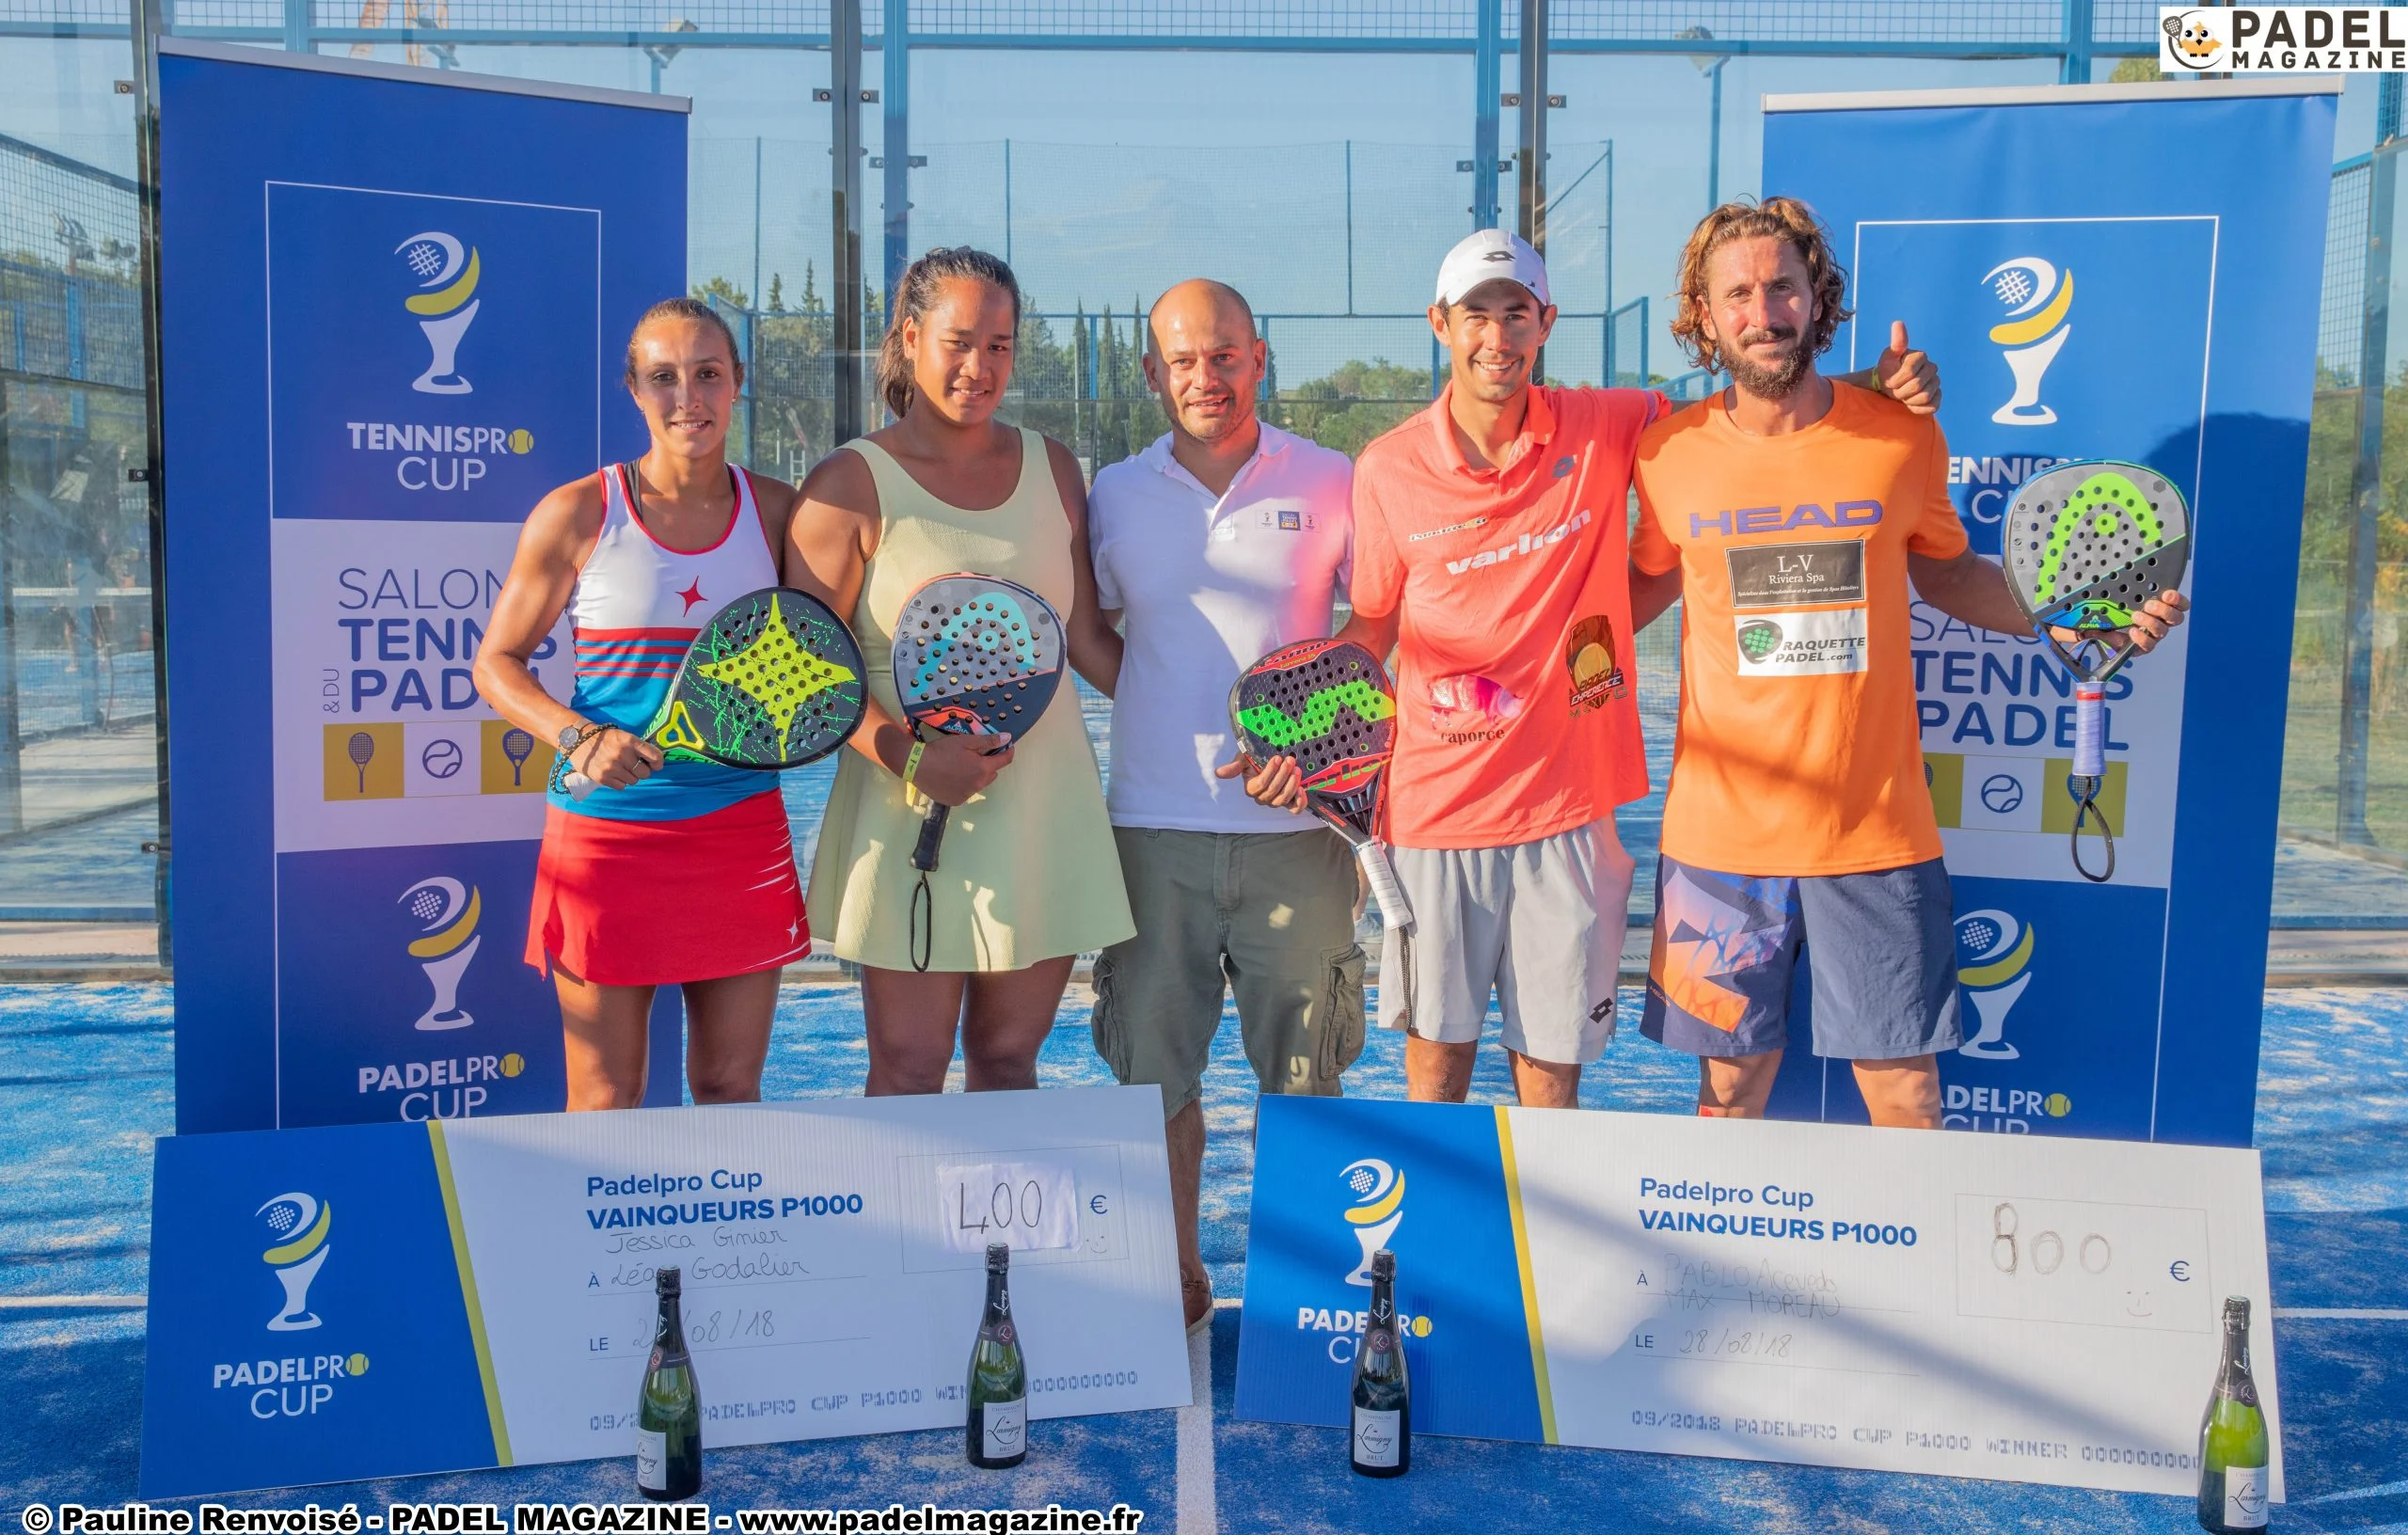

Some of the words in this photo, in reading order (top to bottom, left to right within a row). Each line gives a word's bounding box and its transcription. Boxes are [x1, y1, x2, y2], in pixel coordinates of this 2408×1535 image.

[398, 456, 486, 491] CUP
[1689, 499, 1883, 538] HEAD
[1446, 509, 1592, 576] varlion
[1768, 574, 1803, 584] Riviera
[1806, 572, 1825, 584] Spa
[1777, 554, 1814, 573] L-V
[1782, 637, 1865, 651] RAQUETTE
[323, 669, 340, 697] DU
[400, 1086, 487, 1122] CUP
[1941, 1084, 2072, 1117] DELPRO
[587, 1173, 703, 1197] Padelpro
[710, 1169, 763, 1191] Cup
[1640, 1178, 1754, 1206] Padelpro
[1762, 1185, 1814, 1211] Cup
[587, 1199, 774, 1229] VAINQUEURS
[782, 1194, 863, 1218] P1000
[960, 1180, 1041, 1234] 400
[1089, 1195, 1108, 1214] €
[606, 1231, 696, 1254] Jessica
[1639, 1210, 1825, 1241] VAINQUEURS
[1832, 1221, 1917, 1246] P1000
[1991, 1202, 2112, 1276] 800
[1664, 1253, 1750, 1288] PABLO
[2170, 1260, 2190, 1281] €
[1664, 1289, 1716, 1312] MAX
[1749, 1290, 1841, 1320] MOREAU
[590, 1337, 609, 1352] LE
[1636, 1334, 1654, 1348] LE
[250, 1385, 333, 1418] CUP
[811, 1392, 848, 1411] CUP
[861, 1386, 922, 1407] P1000
[1632, 1410, 1720, 1432] 09/2018
[1735, 1416, 1837, 1441] PADELPRO
[1853, 1427, 1892, 1444] CUP
[1906, 1431, 1972, 1450] P1000
[1987, 1437, 2067, 1459] WINNER
